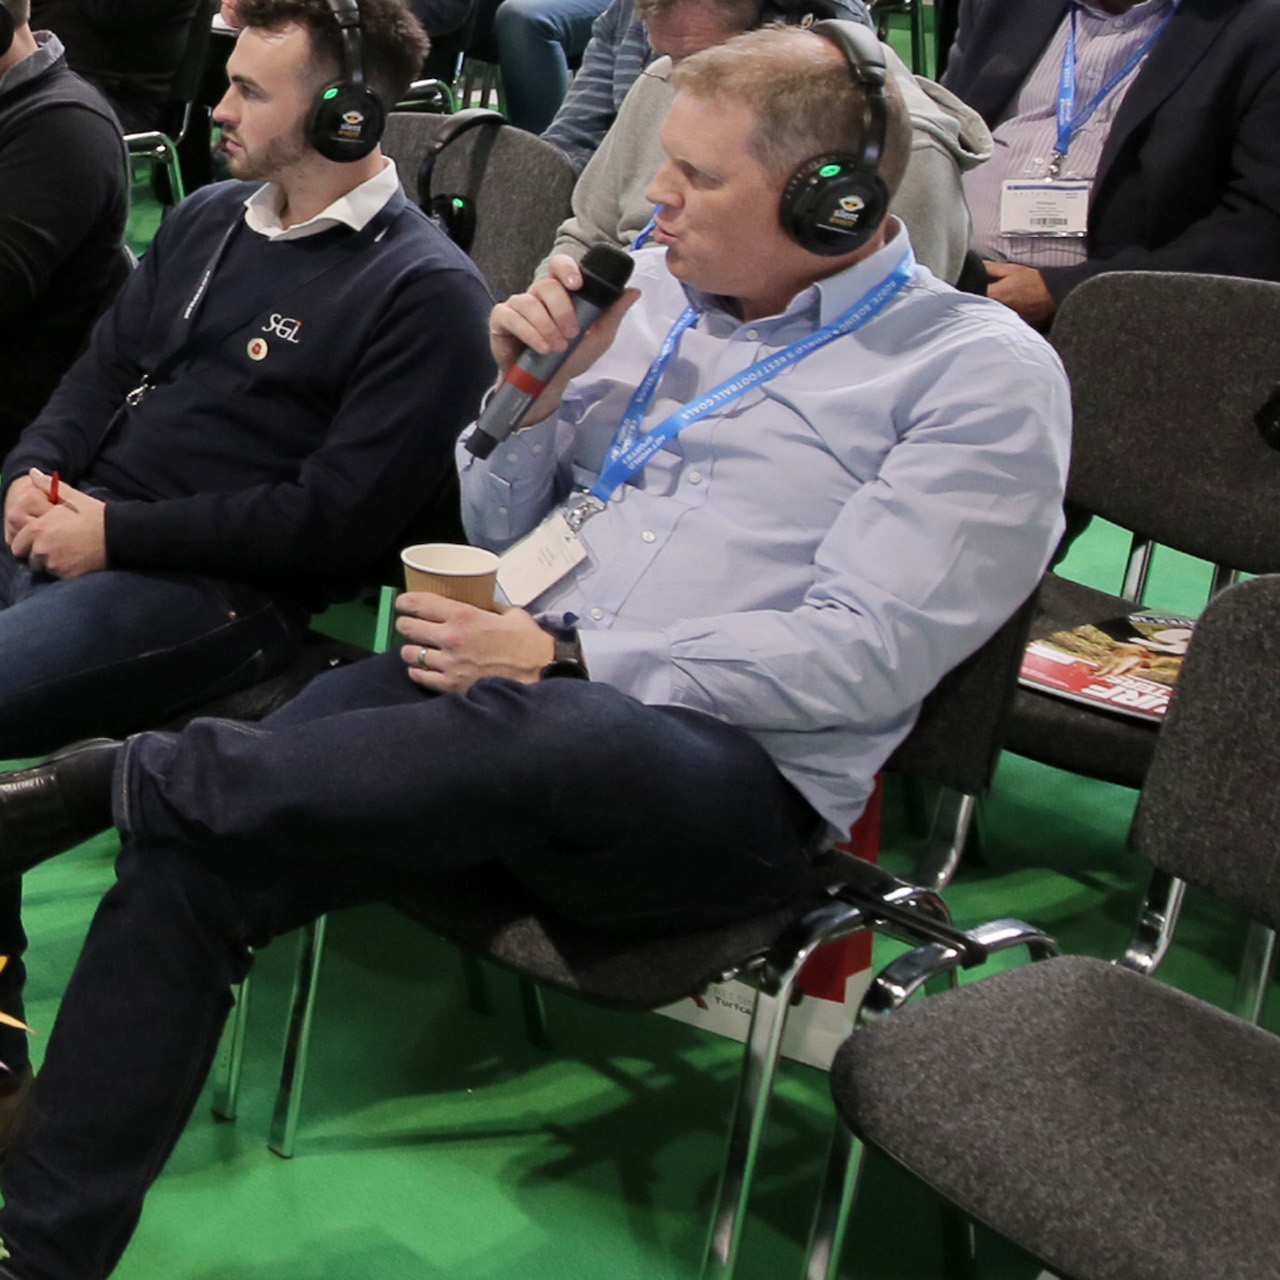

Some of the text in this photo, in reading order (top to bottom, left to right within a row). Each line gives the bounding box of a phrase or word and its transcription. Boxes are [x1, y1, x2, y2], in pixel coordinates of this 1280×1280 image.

[763, 357, 787, 374] BEST
[714, 371, 764, 402] FOOTBALL
[681, 398, 715, 421] GOALS
[1081, 684, 1170, 714] URF
[1103, 675, 1171, 701] TERS
